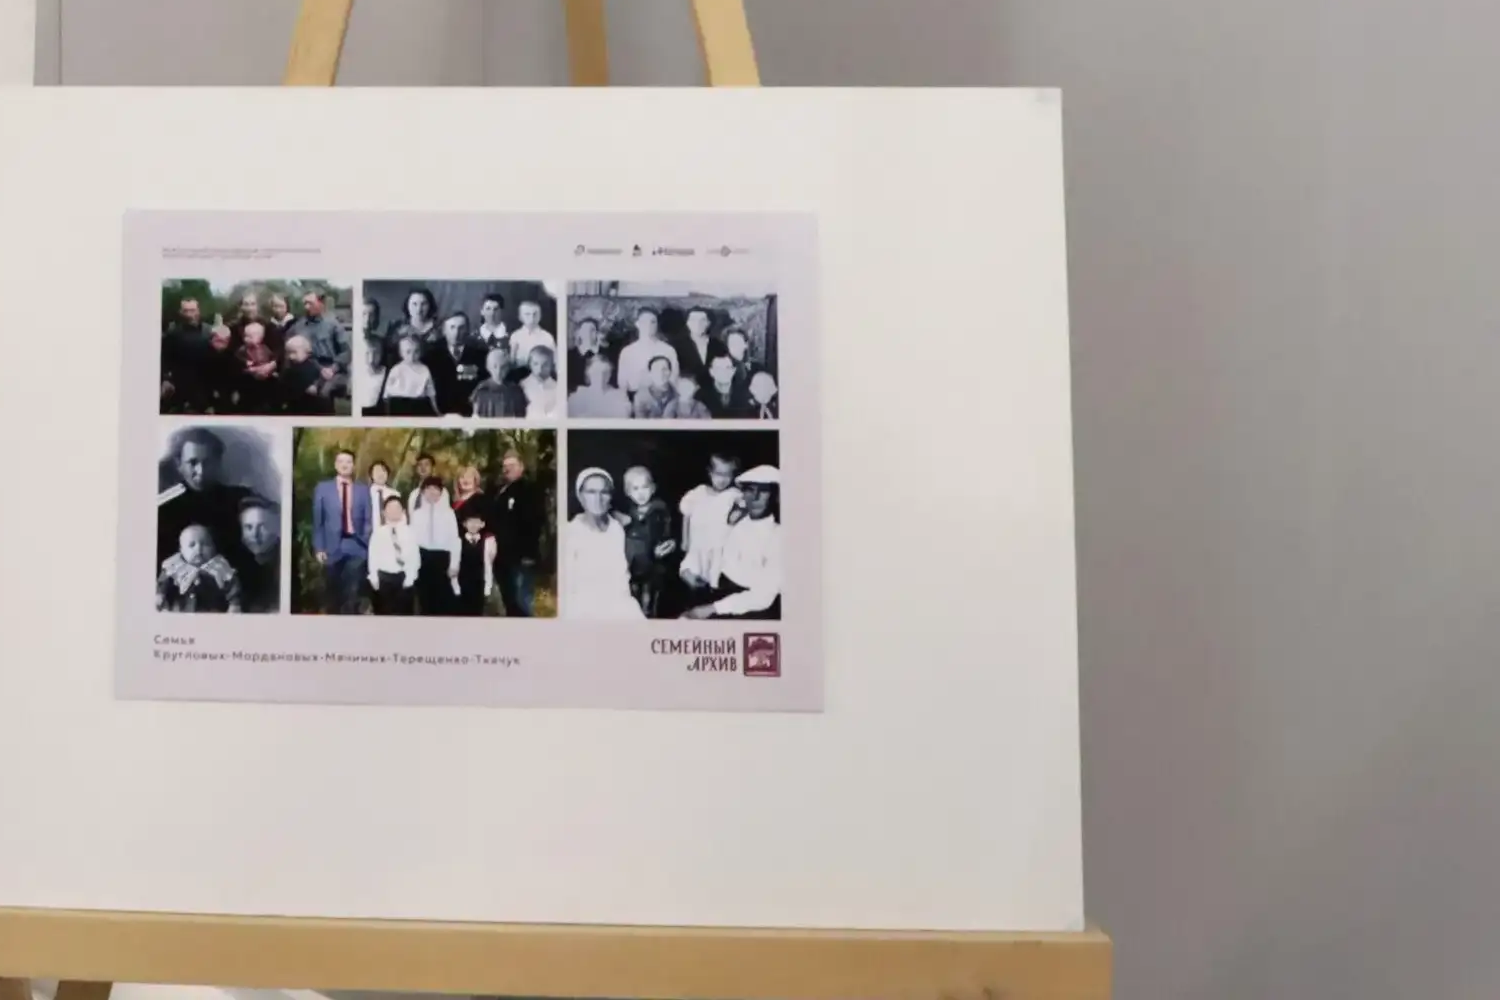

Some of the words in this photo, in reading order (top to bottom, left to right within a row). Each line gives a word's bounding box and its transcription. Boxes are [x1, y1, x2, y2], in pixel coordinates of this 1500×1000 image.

[153, 634, 196, 645] Семья
[651, 636, 737, 655] СЕМЕЙНЫЙ
[686, 655, 738, 672] АРХИВ
